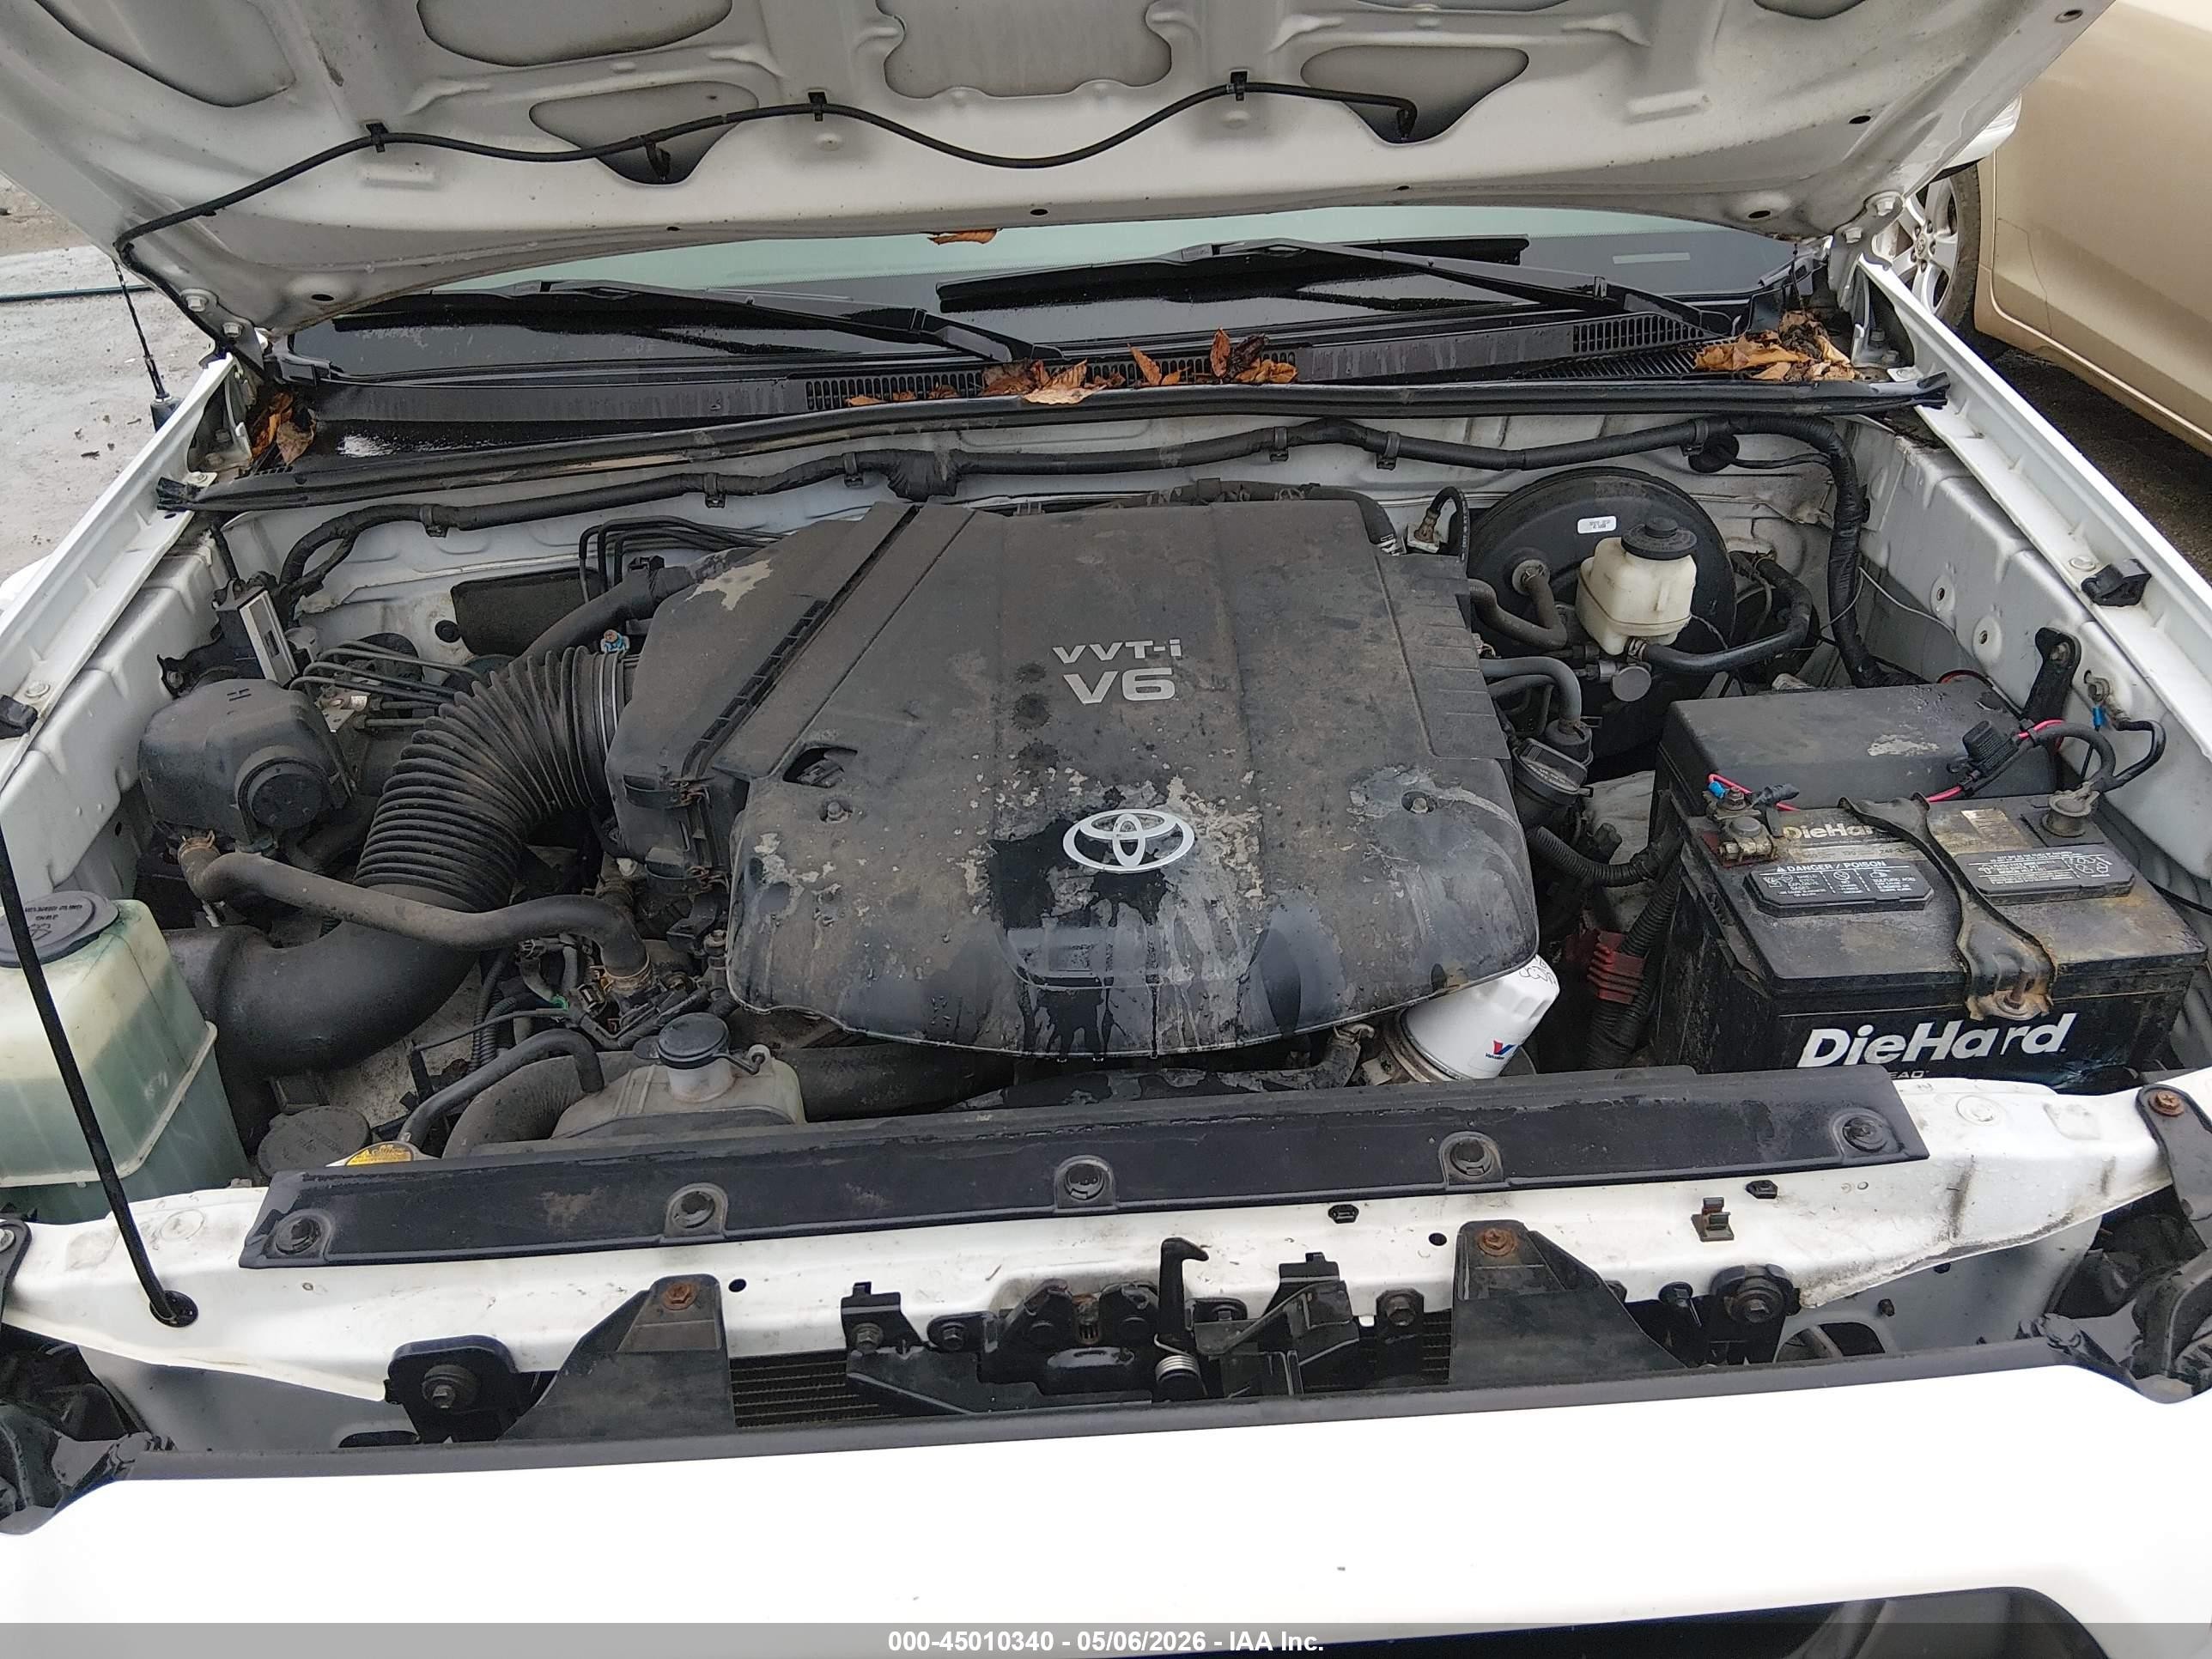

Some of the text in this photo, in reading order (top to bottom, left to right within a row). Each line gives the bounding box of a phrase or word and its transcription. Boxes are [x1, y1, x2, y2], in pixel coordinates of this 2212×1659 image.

[1052, 638, 1182, 664] VVT-i
[1063, 666, 1176, 705] V6
[1783, 823, 1874, 839] DieHar
[1787, 863, 1832, 872] DANGER
[1844, 860, 1887, 869] POISON
[1888, 1070, 1925, 1079] EAD
